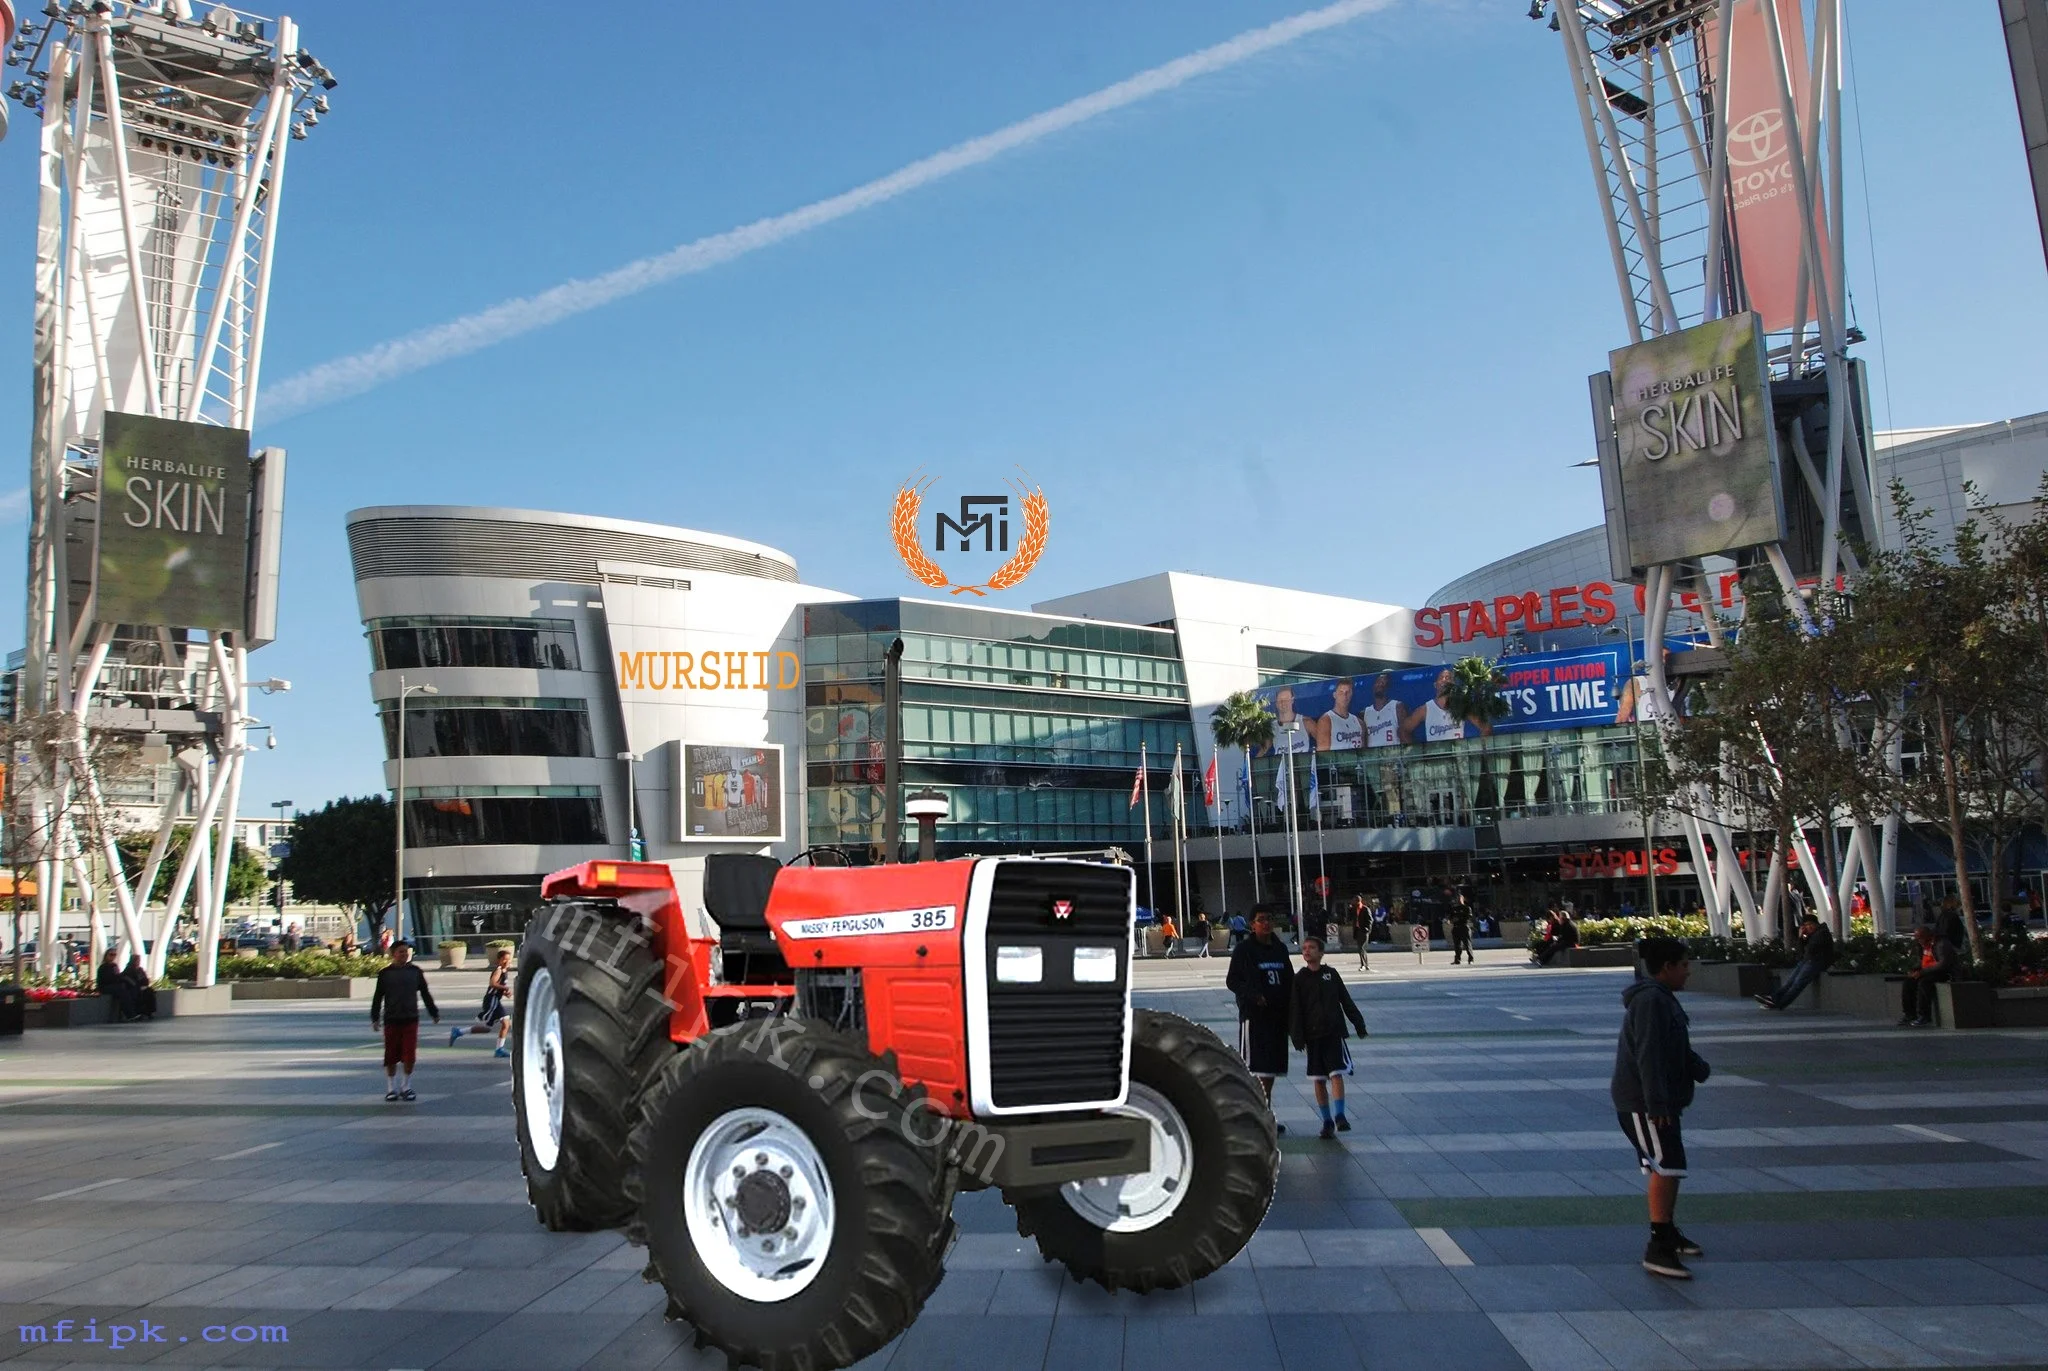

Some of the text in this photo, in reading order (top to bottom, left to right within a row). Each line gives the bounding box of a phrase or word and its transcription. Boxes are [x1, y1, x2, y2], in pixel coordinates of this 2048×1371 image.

[1638, 363, 1735, 401] HERBALIFE
[1640, 384, 1742, 461] SKIN
[126, 456, 226, 479] HERBALIFE
[123, 476, 226, 535] SKIN
[1414, 582, 1617, 648] STAPLES
[1554, 661, 1606, 682] NATION
[1545, 680, 1608, 713] TIME
[1386, 730, 1393, 741] 6
[831, 917, 885, 933] FERGUSON
[911, 909, 947, 928] 385
